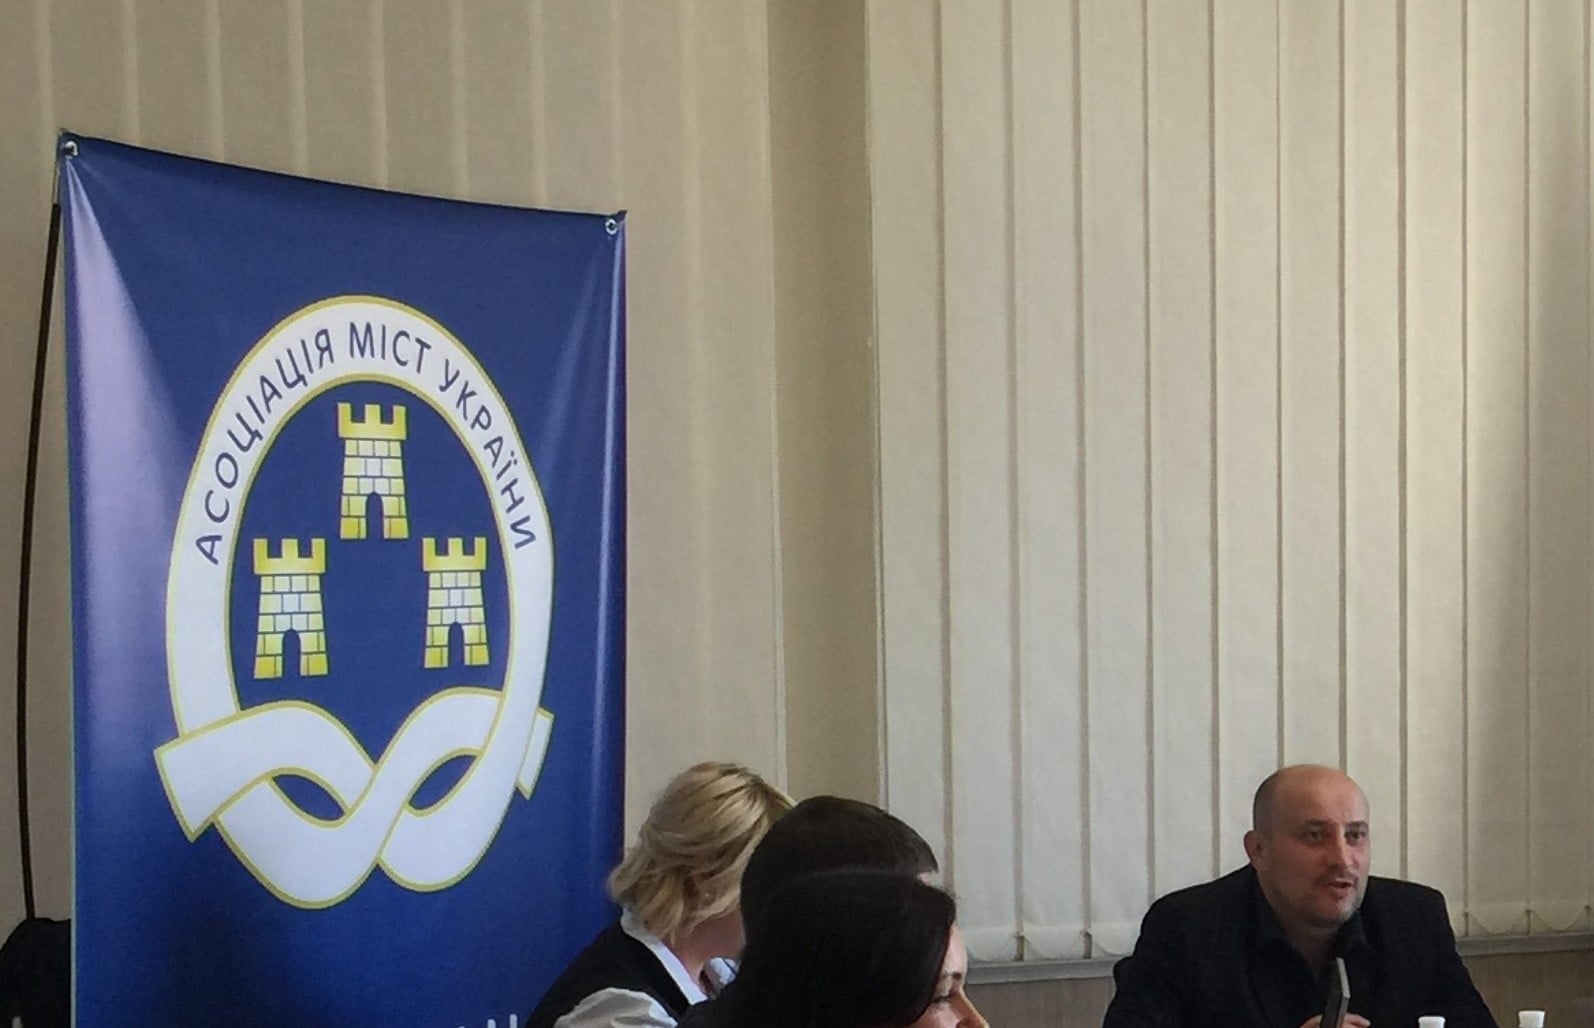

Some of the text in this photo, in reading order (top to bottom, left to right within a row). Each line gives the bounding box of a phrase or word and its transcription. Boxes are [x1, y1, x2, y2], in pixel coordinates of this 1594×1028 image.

[194, 321, 538, 566] АСОЦІАЦІЯ МІСТ УКРАЇНИ
